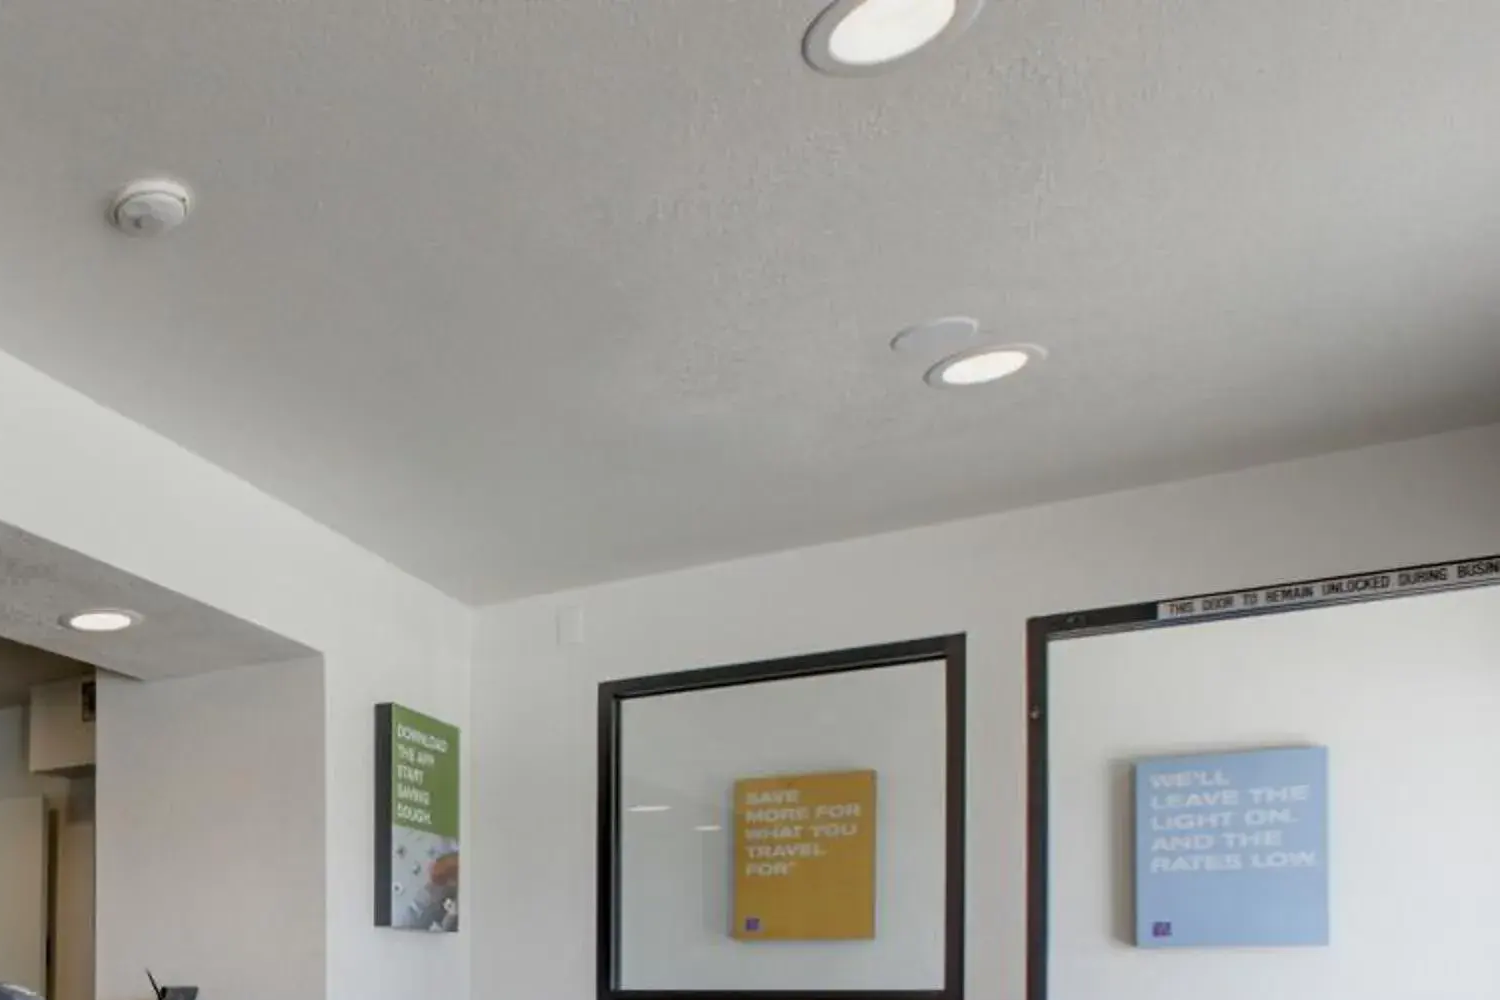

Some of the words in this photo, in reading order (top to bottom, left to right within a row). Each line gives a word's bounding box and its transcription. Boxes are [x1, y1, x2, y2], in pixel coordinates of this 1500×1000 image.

[1168, 600, 1195, 616] THIS
[1201, 595, 1235, 611] DOOR
[1243, 592, 1259, 606] TO
[1265, 584, 1314, 603] REMAIN
[1321, 575, 1391, 596] UNLOCKED
[1398, 567, 1449, 586] DURING
[396, 723, 449, 753] DOWNLOAD
[396, 743, 415, 763] THE
[1150, 769, 1231, 788] WE'LL
[745, 789, 800, 806] SAVE
[1150, 789, 1240, 811] LEAVE
[1249, 784, 1310, 805] THE
[745, 806, 810, 823] MORE
[815, 803, 862, 819] FOR
[1150, 810, 1235, 831] LIGHT
[745, 825, 804, 841] WHAT
[810, 822, 858, 838] YOU
[1150, 833, 1216, 852] AND
[1222, 829, 1284, 849] THE
[745, 842, 825, 859] TRAVEL
[1150, 853, 1244, 874] RATES
